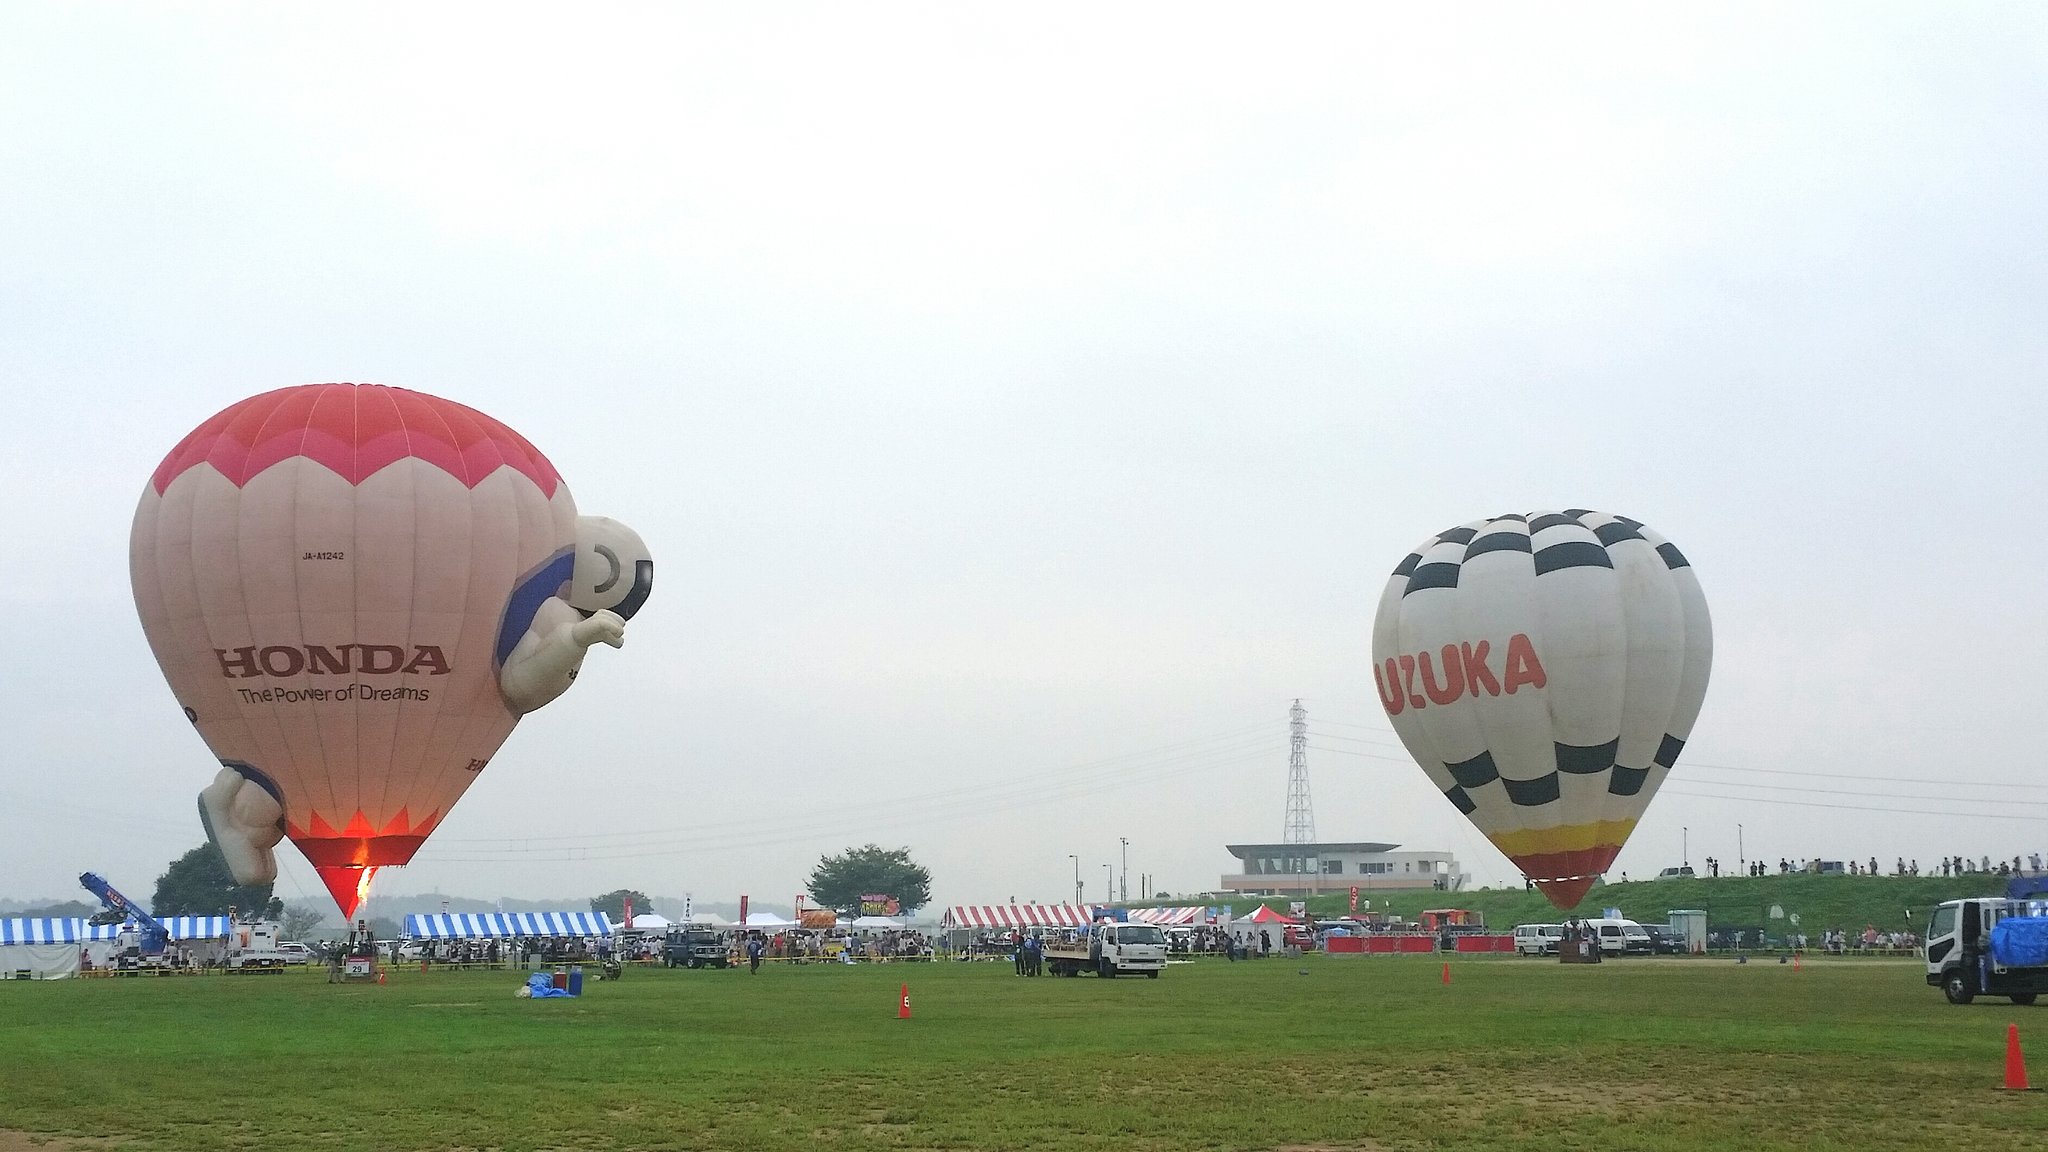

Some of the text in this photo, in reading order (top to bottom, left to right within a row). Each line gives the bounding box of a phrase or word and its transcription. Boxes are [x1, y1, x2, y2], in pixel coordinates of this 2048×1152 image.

[302, 551, 344, 560] JA-A1242
[213, 643, 452, 679] HONDA
[1375, 633, 1547, 715] UZUKA
[237, 684, 431, 704] The Power of Dreams
[352, 965, 362, 973] 29
